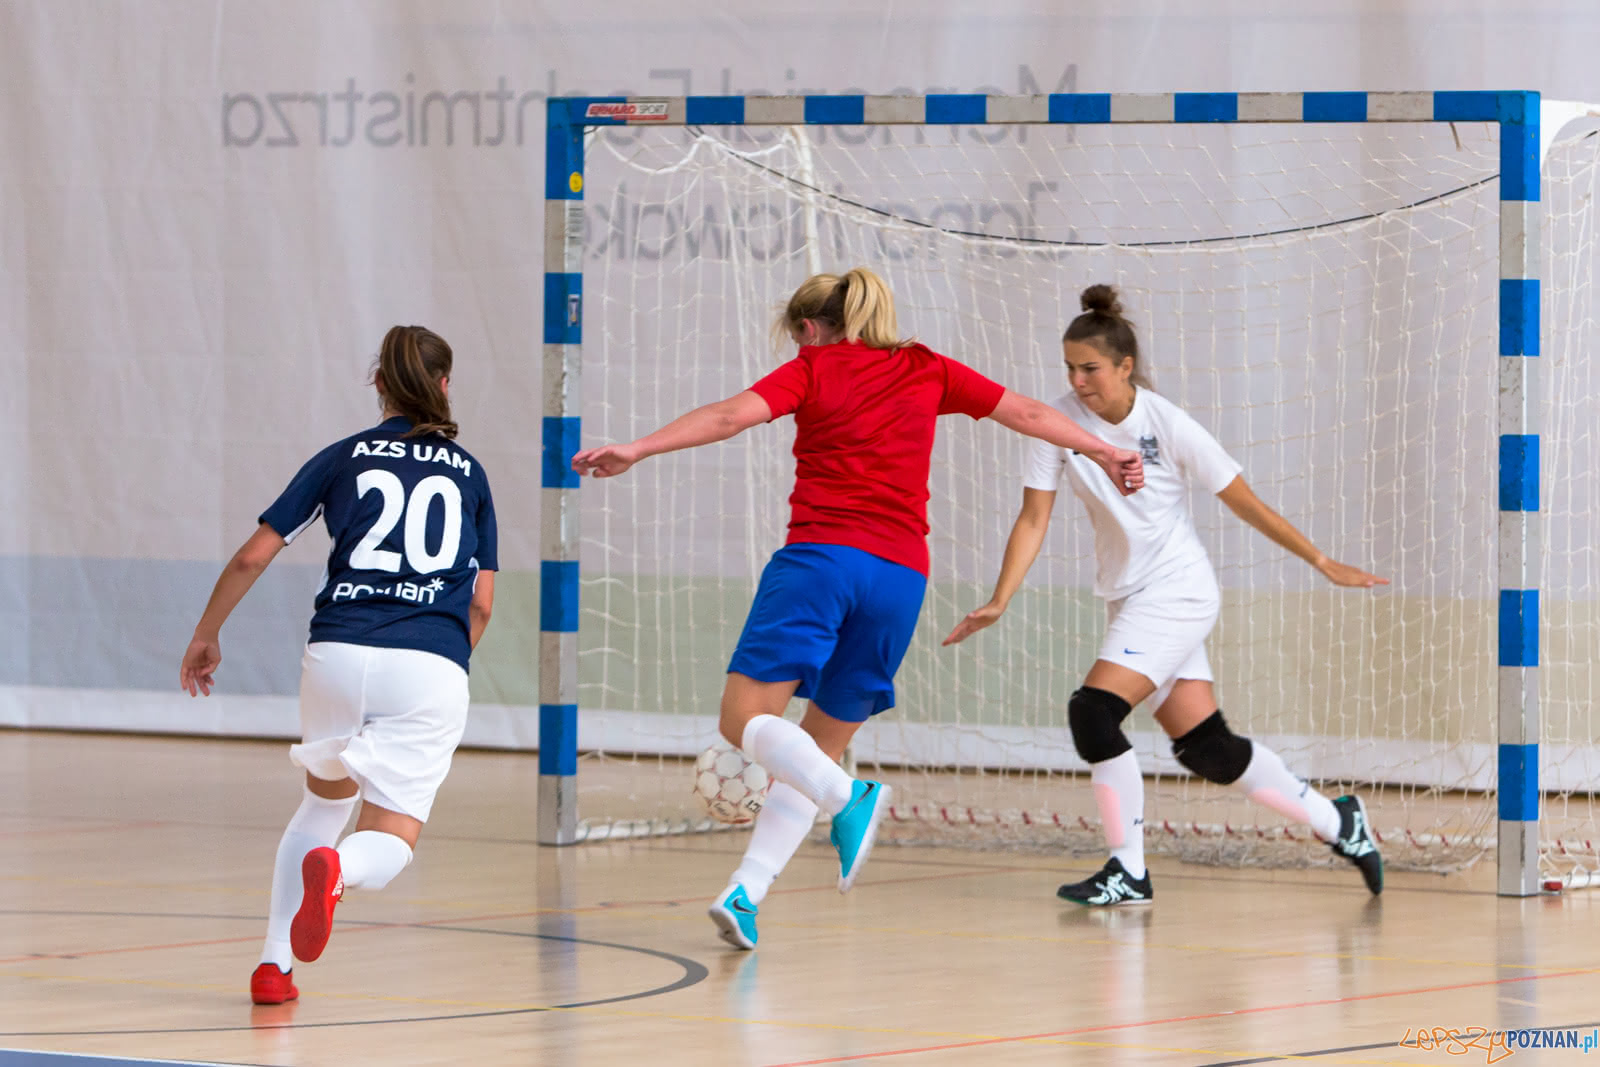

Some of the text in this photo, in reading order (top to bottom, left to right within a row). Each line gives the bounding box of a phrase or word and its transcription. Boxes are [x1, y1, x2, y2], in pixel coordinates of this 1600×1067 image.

[352, 440, 471, 477] AZS UAM
[348, 468, 463, 575] 20
